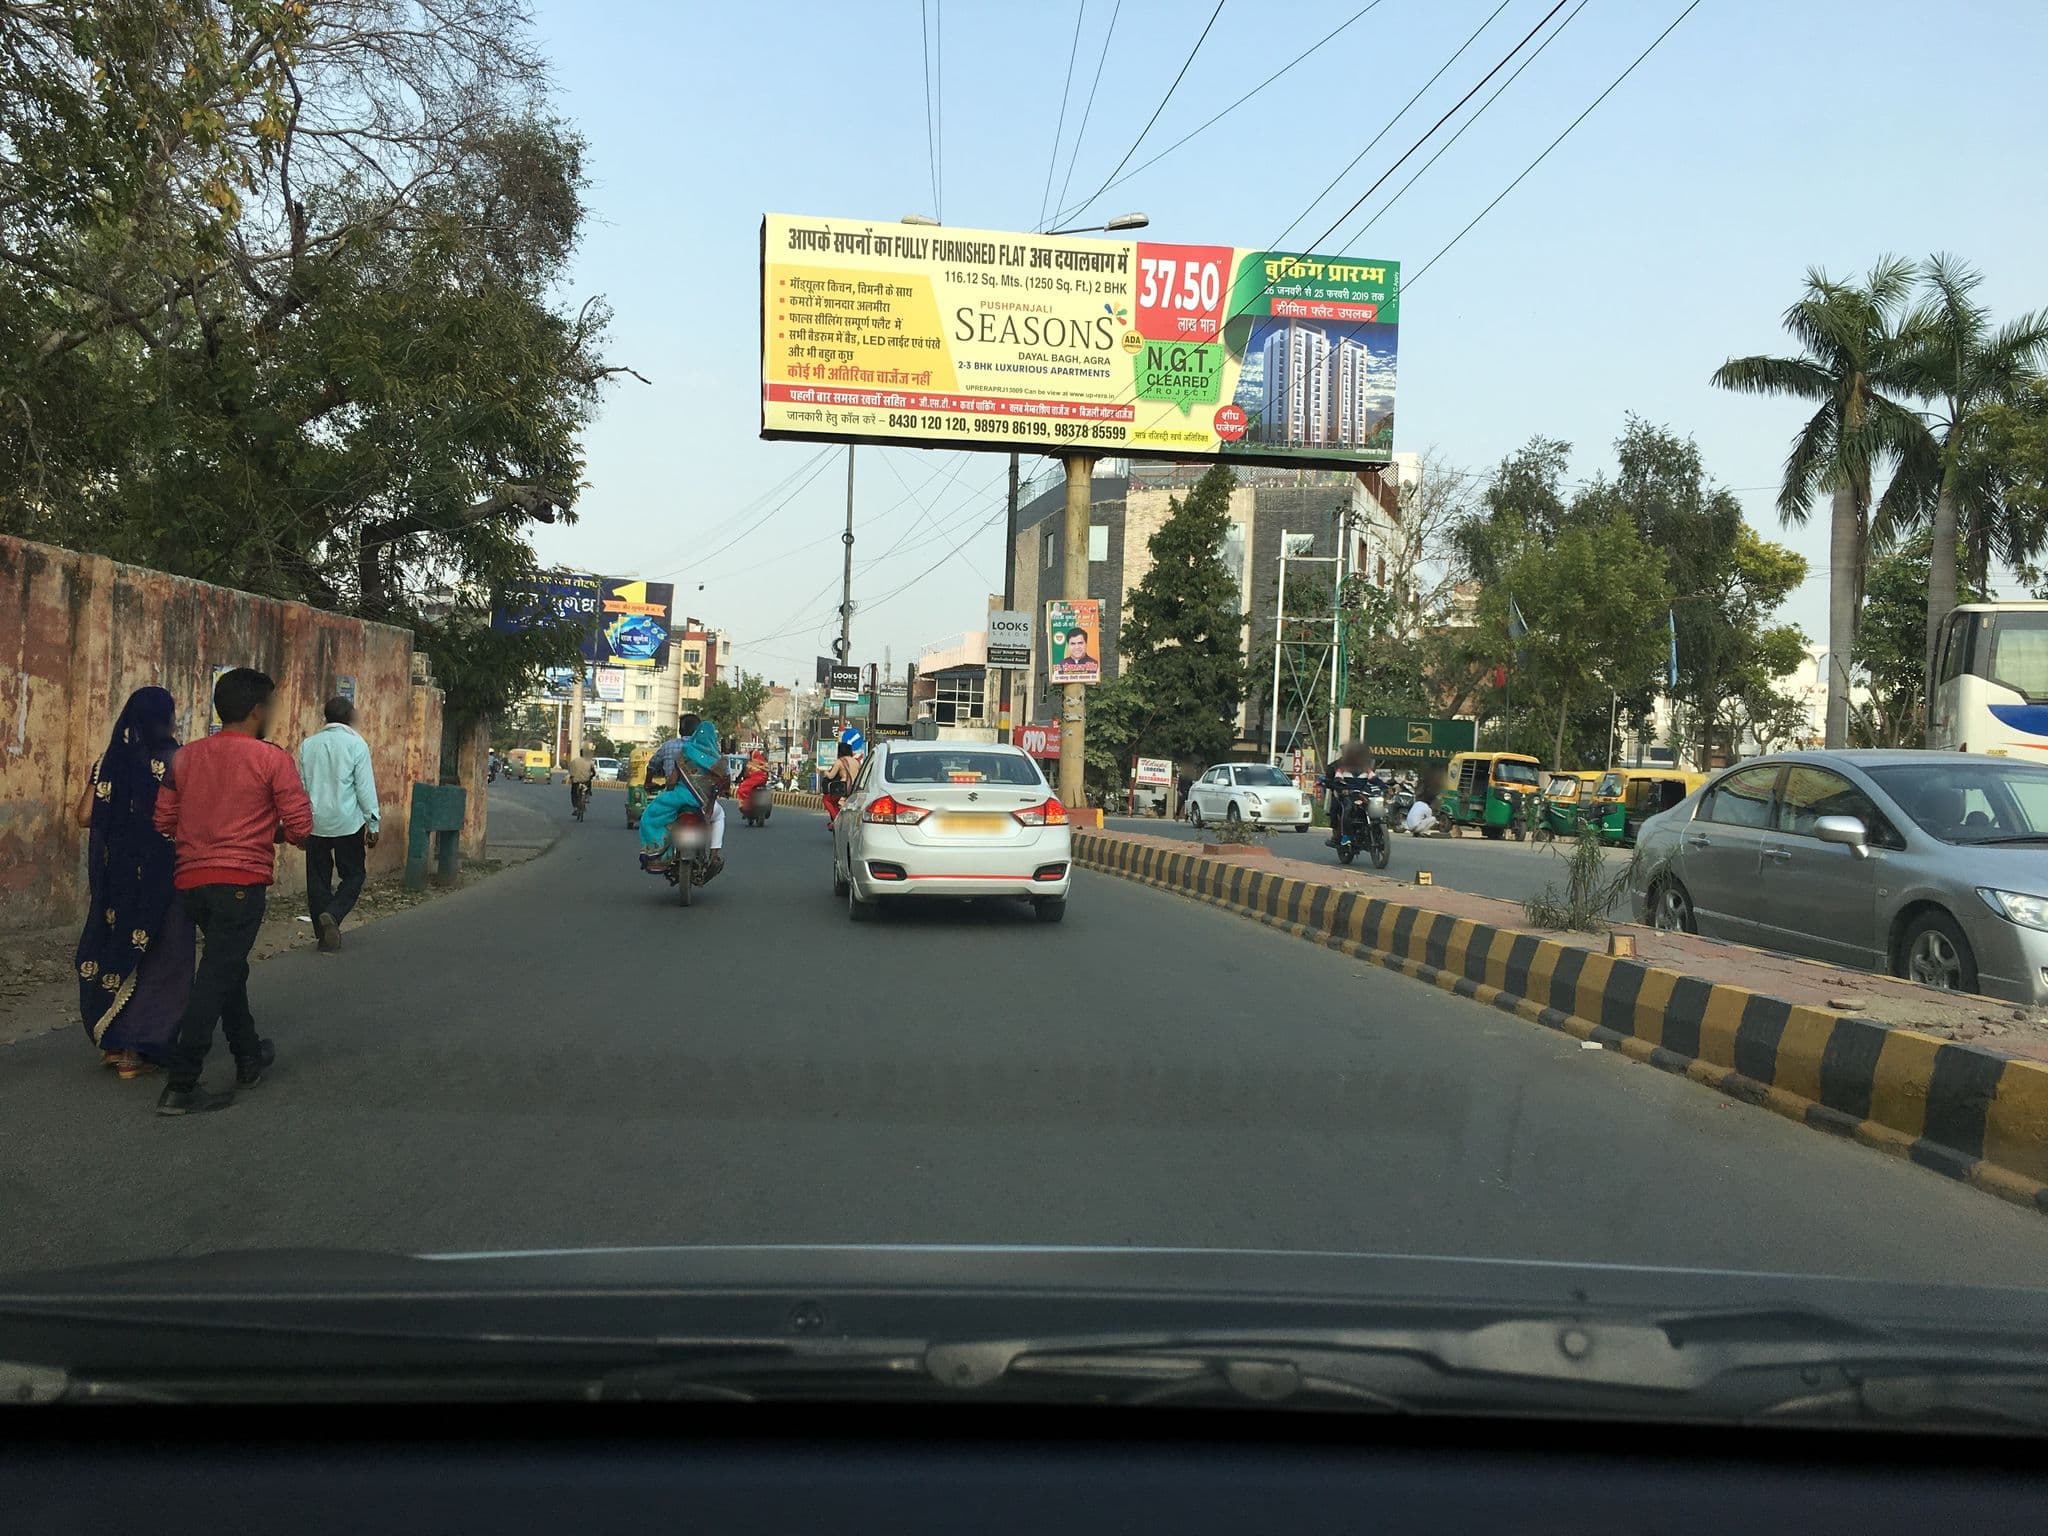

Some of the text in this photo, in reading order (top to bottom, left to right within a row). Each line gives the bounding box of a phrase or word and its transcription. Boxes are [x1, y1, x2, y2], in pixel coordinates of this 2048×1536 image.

[788, 225, 1130, 274] आपके सपनों का FULLY FURNISHED FLAT अब दयालबाग में
[1264, 256, 1386, 284] बुकिंग प्रारम्भ
[827, 279, 855, 294] किचन,
[858, 282, 883, 296] चिमनी
[885, 284, 894, 296] के
[895, 287, 913, 297] साथ
[945, 271, 1127, 295] 116.12 Sq. Mts. (1250 Sq. Ft.) 2 BHK
[1277, 285, 1302, 296] जनवरी
[1304, 287, 1312, 297] से
[1314, 290, 1324, 298] 25
[1326, 288, 1350, 299] फरवरी
[1352, 291, 1369, 301] 2019
[1371, 292, 1384, 301] तक
[790, 294, 891, 312] कमरों में शानदार अलमीरा
[980, 300, 1053, 313] PUSHPANJALI
[1276, 301, 1307, 315] सीमित
[1311, 304, 1334, 317] फ्लैट
[789, 313, 812, 325] फाल्स
[814, 312, 843, 326] सीलिंग
[871, 318, 891, 329] फ्लैट
[895, 318, 904, 330] में
[955, 307, 1114, 350] SEASONS
[1177, 317, 1216, 333] लाख मात्र
[789, 329, 806, 341] सभी
[836, 331, 844, 343] में
[863, 335, 886, 346] LED
[888, 336, 909, 348] लाईट
[911, 337, 923, 349] एवं
[1124, 336, 1141, 344] ADA
[788, 344, 854, 363] और भी बहुत कुछ
[1018, 352, 1111, 365] DAYAL BAGH, AGRA
[1147, 346, 1213, 373] N.G.T.
[787, 363, 933, 386] कोई भी अतिरिक्त चार्जेज नहीं
[958, 361, 1110, 378] 2-3 BHK LUXURIOUS APARTMENTS
[1147, 374, 1209, 388] CLEARED
[790, 389, 815, 401] पहली
[816, 392, 831, 402] बार
[833, 393, 859, 404] समस्त
[883, 394, 906, 407] सहित
[1147, 387, 1208, 396] PROJECT
[786, 409, 1126, 440] जानकारी हेतु कॉल करें 8430 120 120, 98979 86199, 98378 85599
[992, 621, 1029, 632] LOOKS
[598, 675, 620, 683] OPEN
[1023, 730, 1046, 752] OYO
[1368, 746, 1424, 757] MANSINGH
